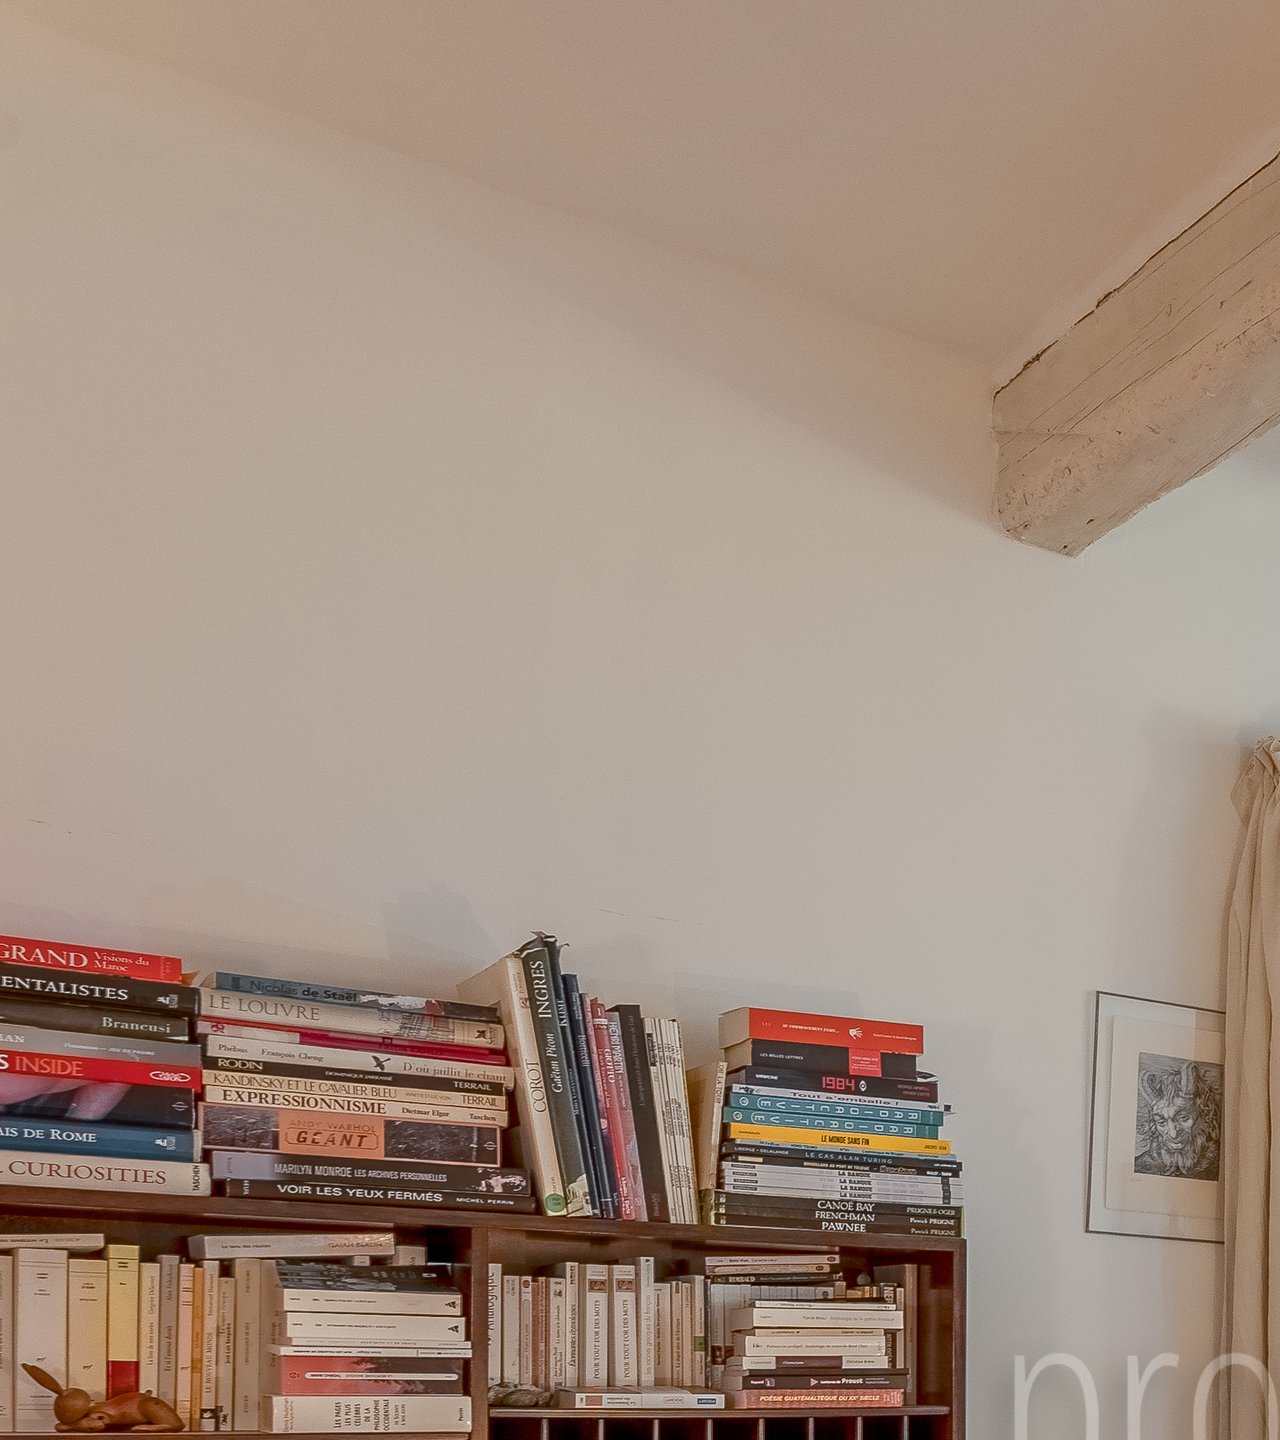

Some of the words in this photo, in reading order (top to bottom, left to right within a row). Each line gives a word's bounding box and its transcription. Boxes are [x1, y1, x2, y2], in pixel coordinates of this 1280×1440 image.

[94, 959, 129, 973] Maroc
[1, 975, 129, 1001] ENTALISTES
[250, 980, 297, 996] Nicolas
[302, 987, 320, 998] de
[531, 960, 553, 1018] INGRES
[209, 995, 231, 1010] LE
[238, 998, 320, 1022] LOUVRE
[102, 1017, 171, 1034] Brancusi
[15, 1056, 83, 1077] INSIDE
[218, 1058, 263, 1070] RODIN
[214, 1073, 285, 1089] KANDINSKY
[286, 1079, 301, 1090] ET
[303, 1081, 316, 1092] LE
[318, 1082, 369, 1096] CAVALIER
[371, 1087, 397, 1098] BLEU
[524, 1058, 548, 1113] COROT
[822, 1076, 855, 1091] 1984
[222, 1089, 387, 1115] EXPRESSIONNISME
[23, 1128, 45, 1139] DE
[820, 1135, 828, 1143] LE
[828, 1135, 847, 1144] MONDE
[9, 1160, 167, 1185] CURIOSITIES
[191, 1164, 200, 1192] TASCHEN
[274, 1162, 313, 1175] MARILYN
[314, 1165, 352, 1177] MONROE
[276, 1183, 312, 1195] VOIR
[316, 1186, 341, 1196] LES
[346, 1187, 384, 1199] YEUX
[387, 1189, 443, 1203] FERMÉS
[815, 1210, 875, 1222] FRENCHMAN
[856, 1202, 875, 1212] BAY
[821, 1221, 867, 1232] PAWNEE
